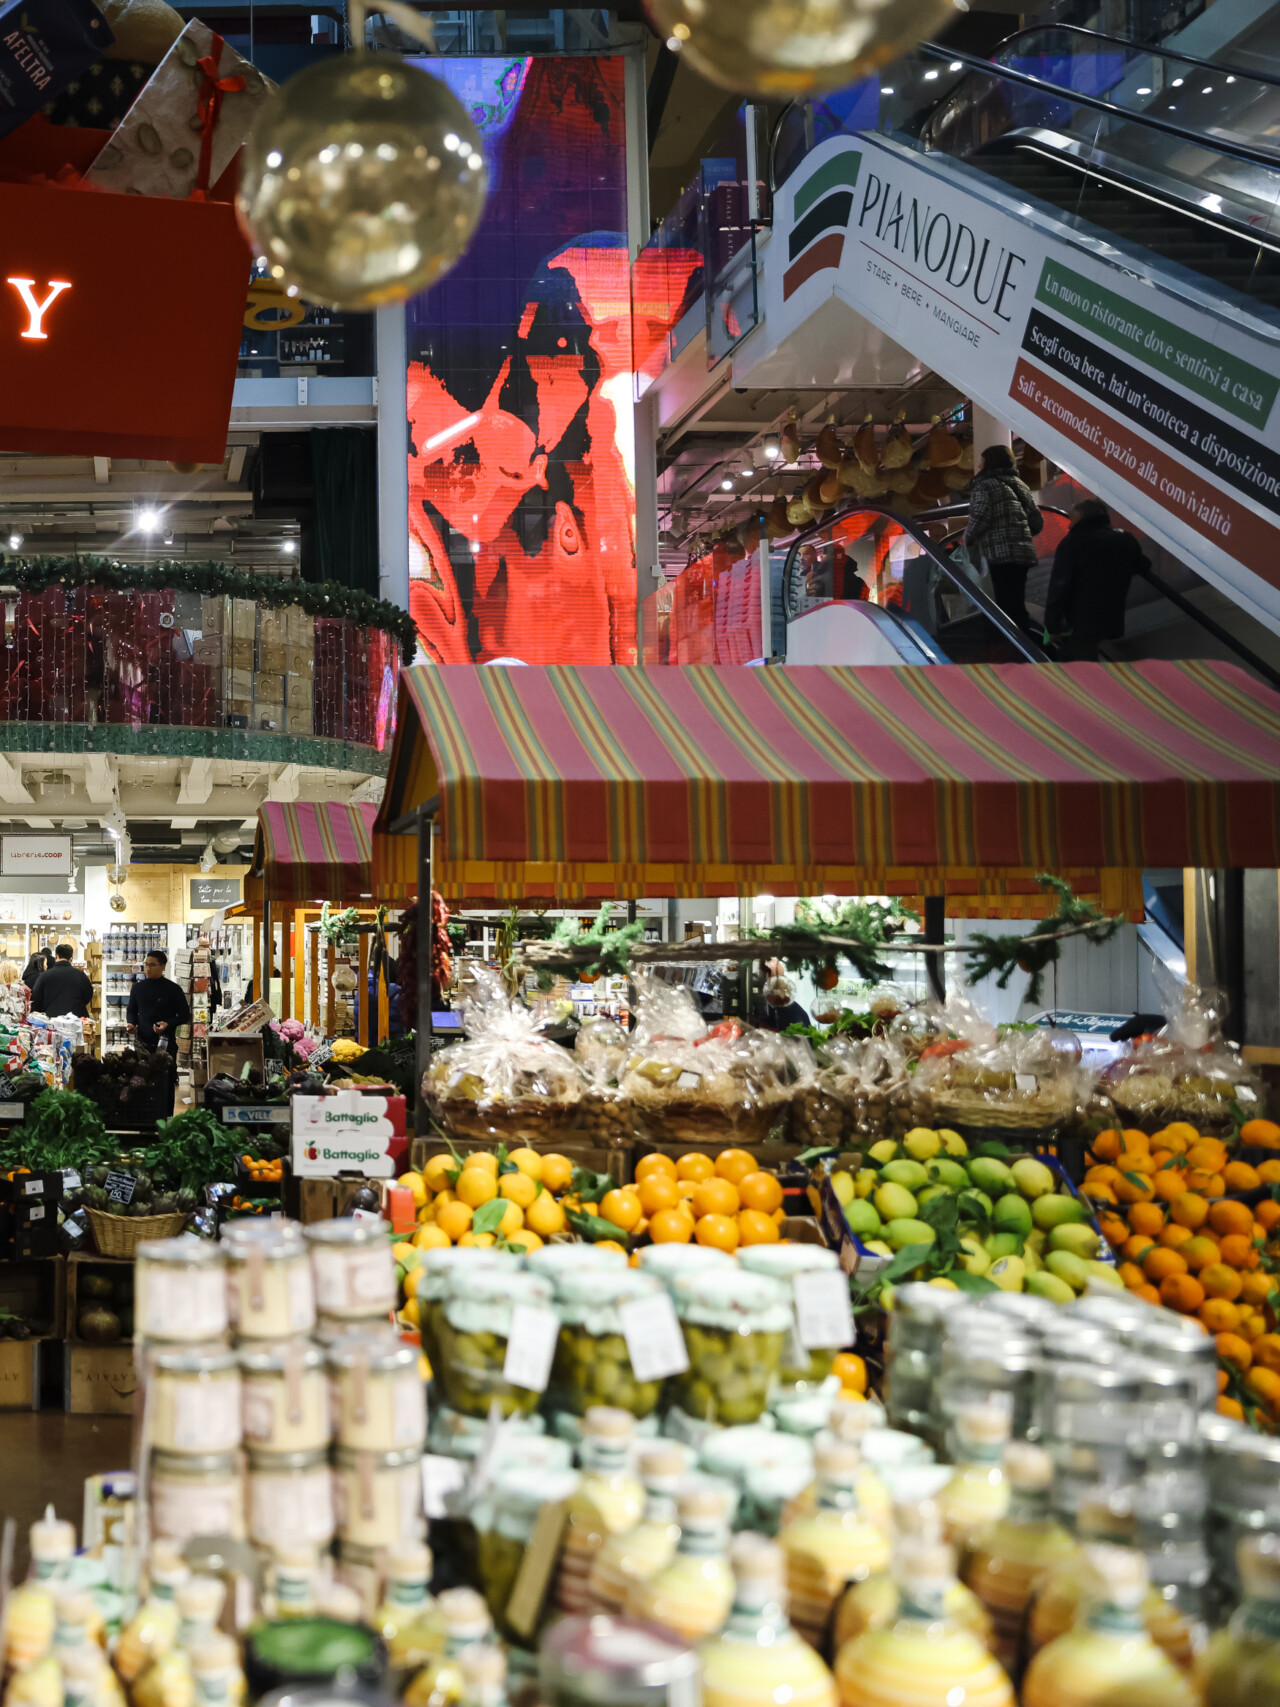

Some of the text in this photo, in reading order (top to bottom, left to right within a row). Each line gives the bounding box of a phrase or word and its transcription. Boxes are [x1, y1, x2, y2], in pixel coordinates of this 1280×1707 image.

[2, 30, 52, 91] AFELTRA
[858, 173, 1026, 323] PIANODUE
[866, 260, 981, 348] STARE BERE MANGIARE
[1044, 273, 1264, 411] Un nuovo ristorante dove sentirsi a casa
[1017, 374, 1232, 537] Sali e accomodati: spazio alla convivialità
[1030, 325, 1280, 498] Scegli cosa bere, hai un'enoteca a disposizione
[10, 851, 63, 859] librerie.coop
[322, 1148, 380, 1163] Battaglio
[325, 1111, 379, 1126] Battaglio
